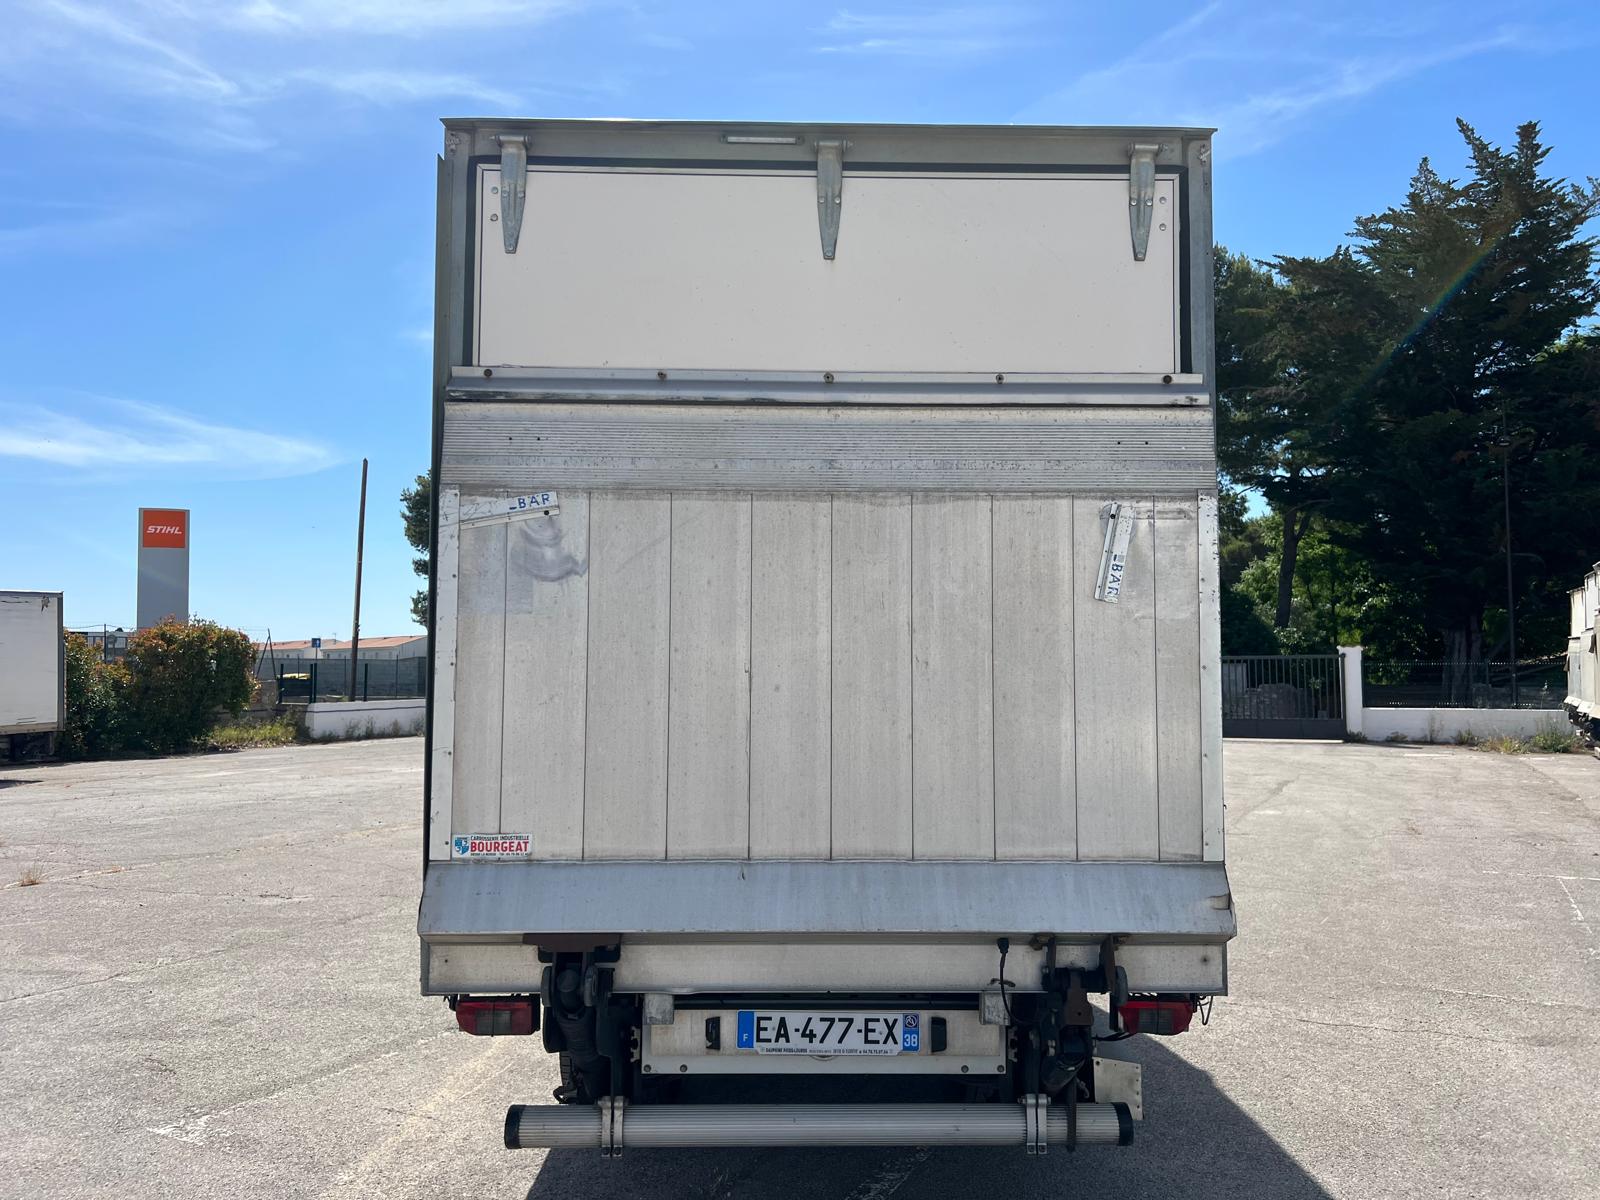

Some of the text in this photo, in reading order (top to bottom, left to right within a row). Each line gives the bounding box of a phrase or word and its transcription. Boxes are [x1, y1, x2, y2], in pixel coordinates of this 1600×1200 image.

[146, 525, 182, 535] STIHL
[470, 841, 530, 852] BOURGEAT
[742, 1016, 918, 1047] F EA-477-EX 38
